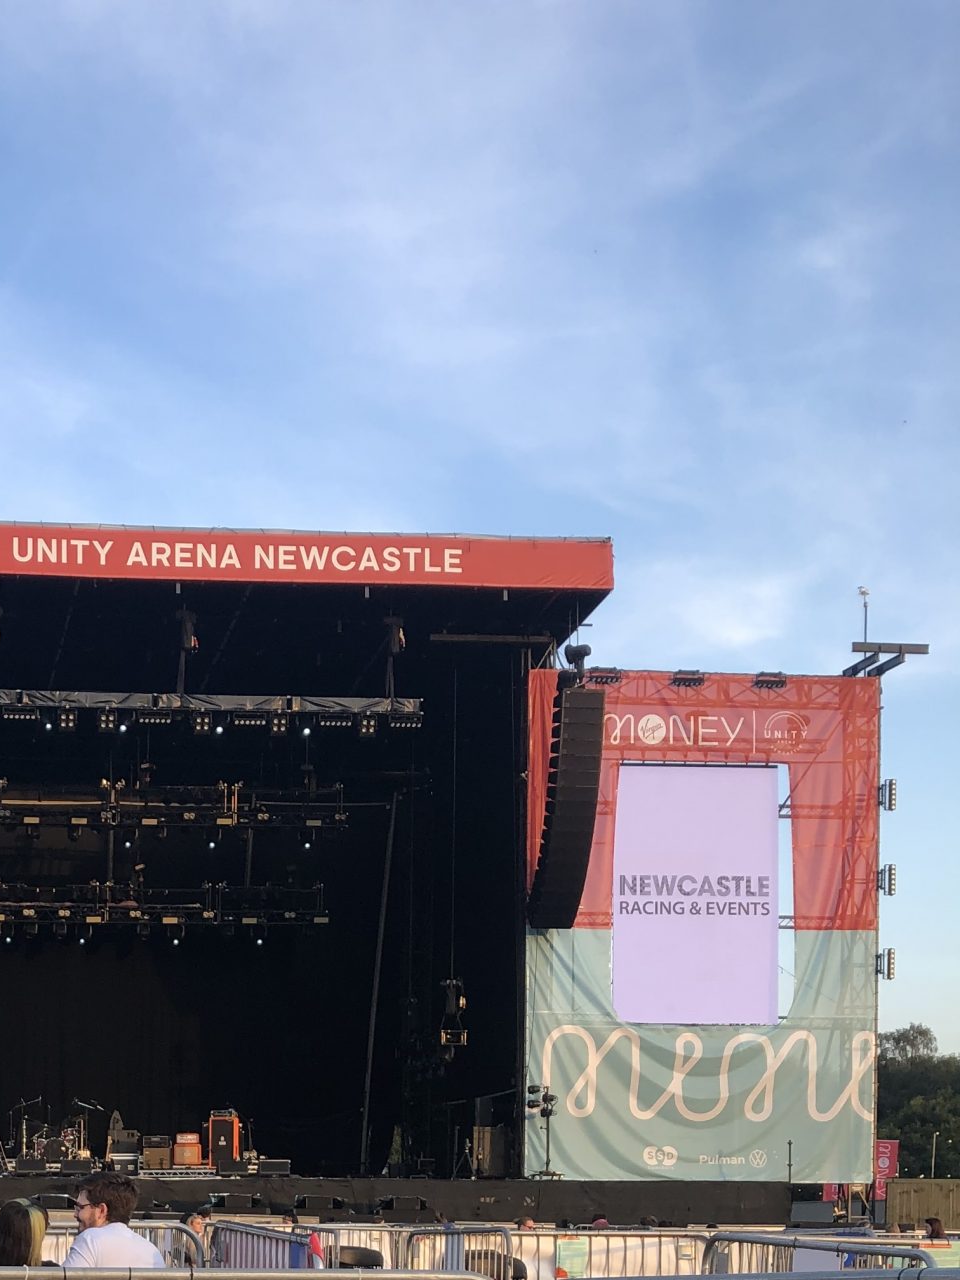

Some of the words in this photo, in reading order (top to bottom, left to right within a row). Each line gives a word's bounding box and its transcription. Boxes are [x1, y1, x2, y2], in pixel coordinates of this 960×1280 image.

[12, 536, 113, 565] UNITY
[126, 541, 242, 569] ARENA
[254, 544, 463, 574] NEWCASTLE
[764, 729, 808, 740] UNITY
[619, 874, 770, 897] NEWCASTLE
[619, 900, 685, 915] RACING
[690, 901, 702, 916] &
[706, 901, 771, 916] EVENTS
[699, 1154, 746, 1165] Pulman
